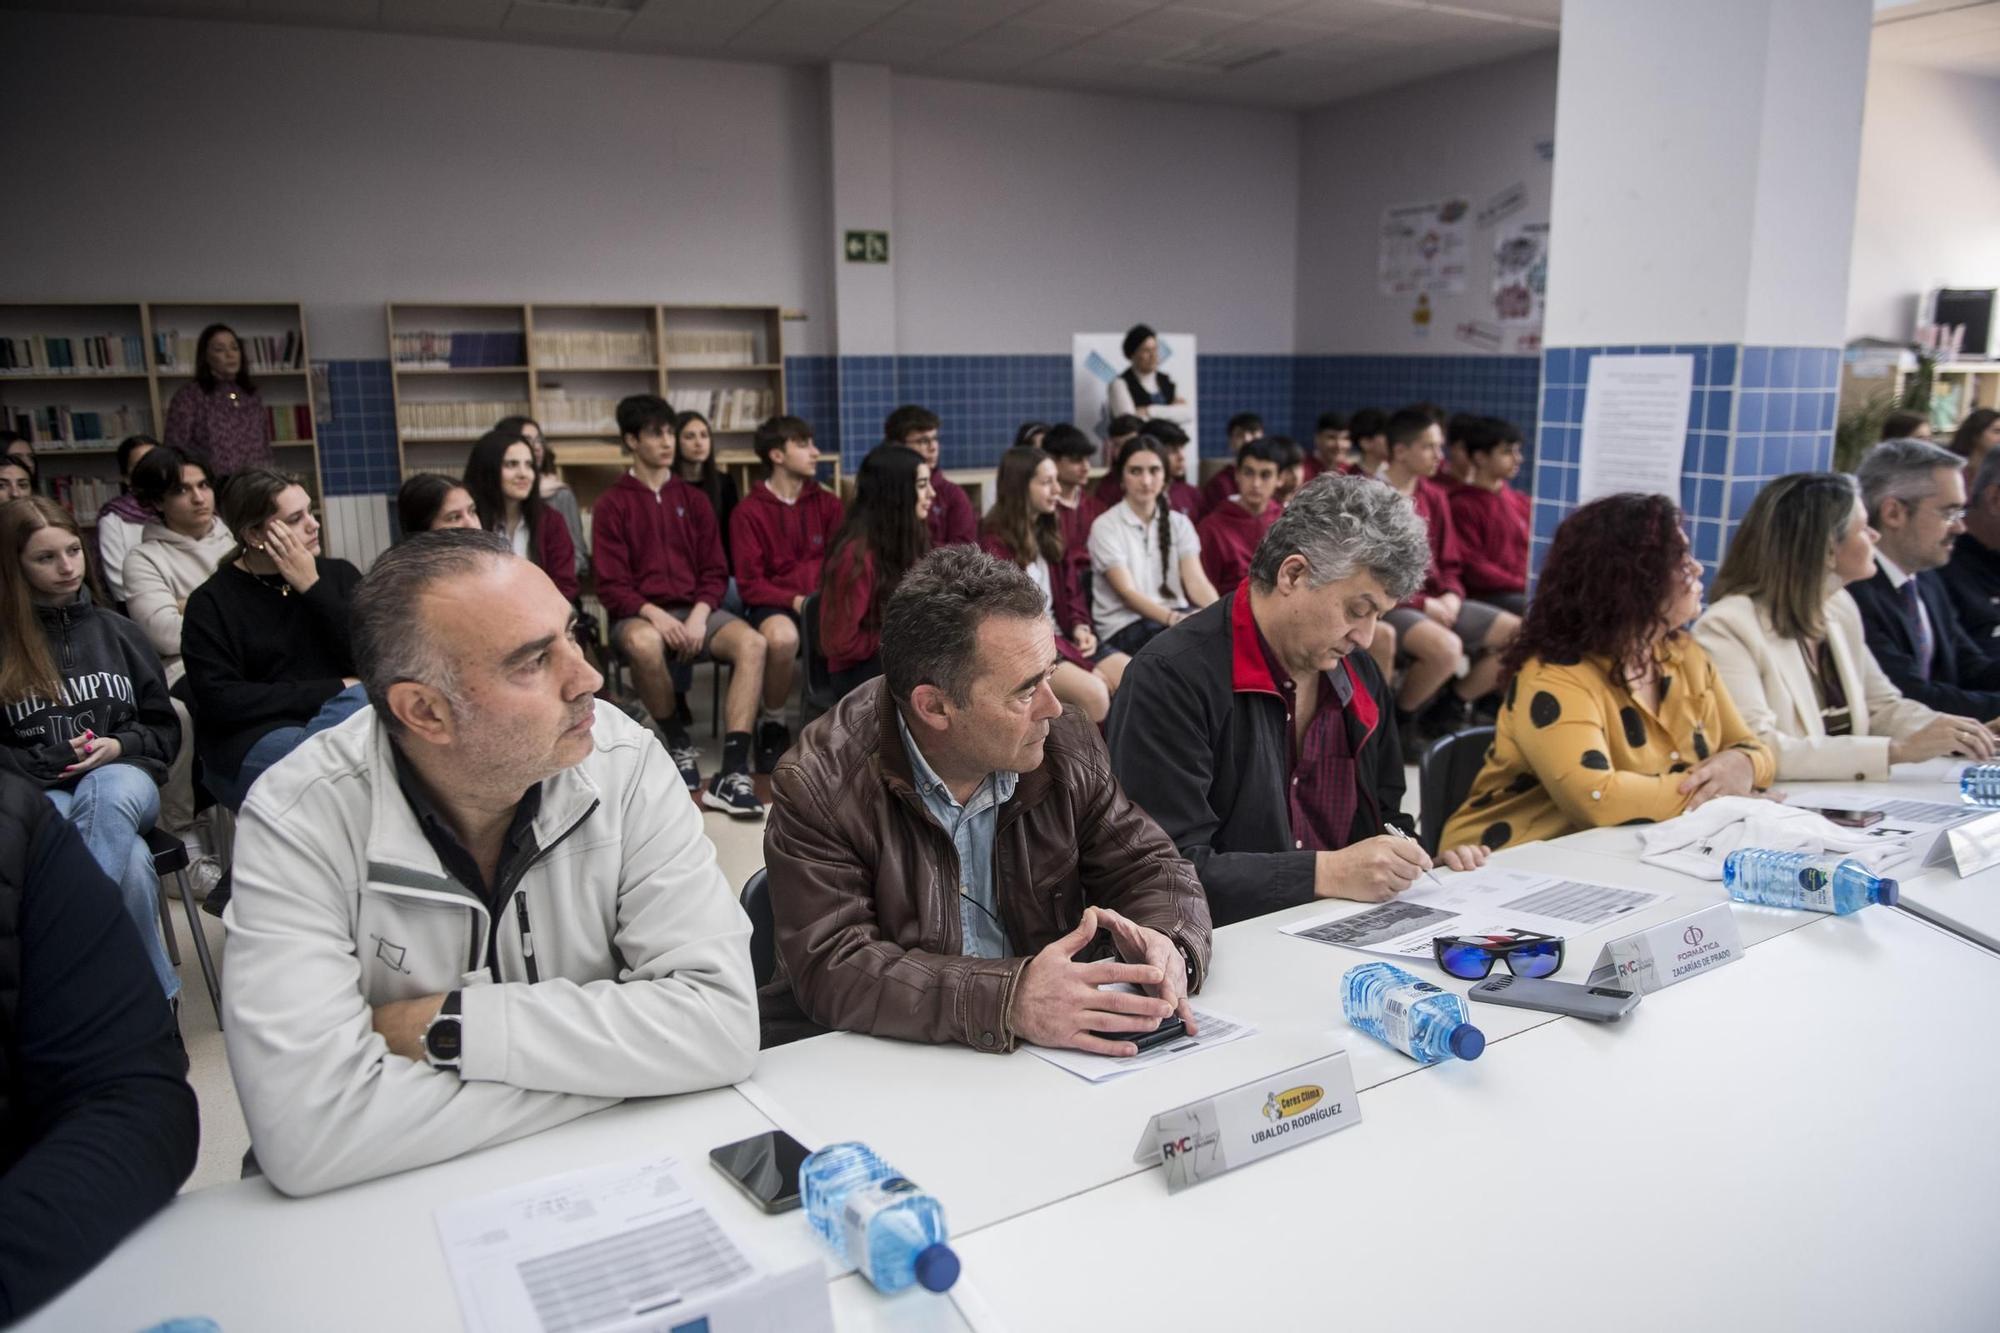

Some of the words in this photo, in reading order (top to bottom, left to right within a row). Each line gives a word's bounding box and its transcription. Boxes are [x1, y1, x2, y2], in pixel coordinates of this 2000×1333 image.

[1701, 956, 1712, 967] DE
[1709, 949, 1732, 964] PRADO
[1281, 1095, 1302, 1110] Ceres
[1301, 1088, 1321, 1103] Clima
[1251, 1122, 1290, 1145] UBALDO
[1291, 1103, 1343, 1131] RODRÍGUEZ
[1163, 1136, 1193, 1160] RMC
